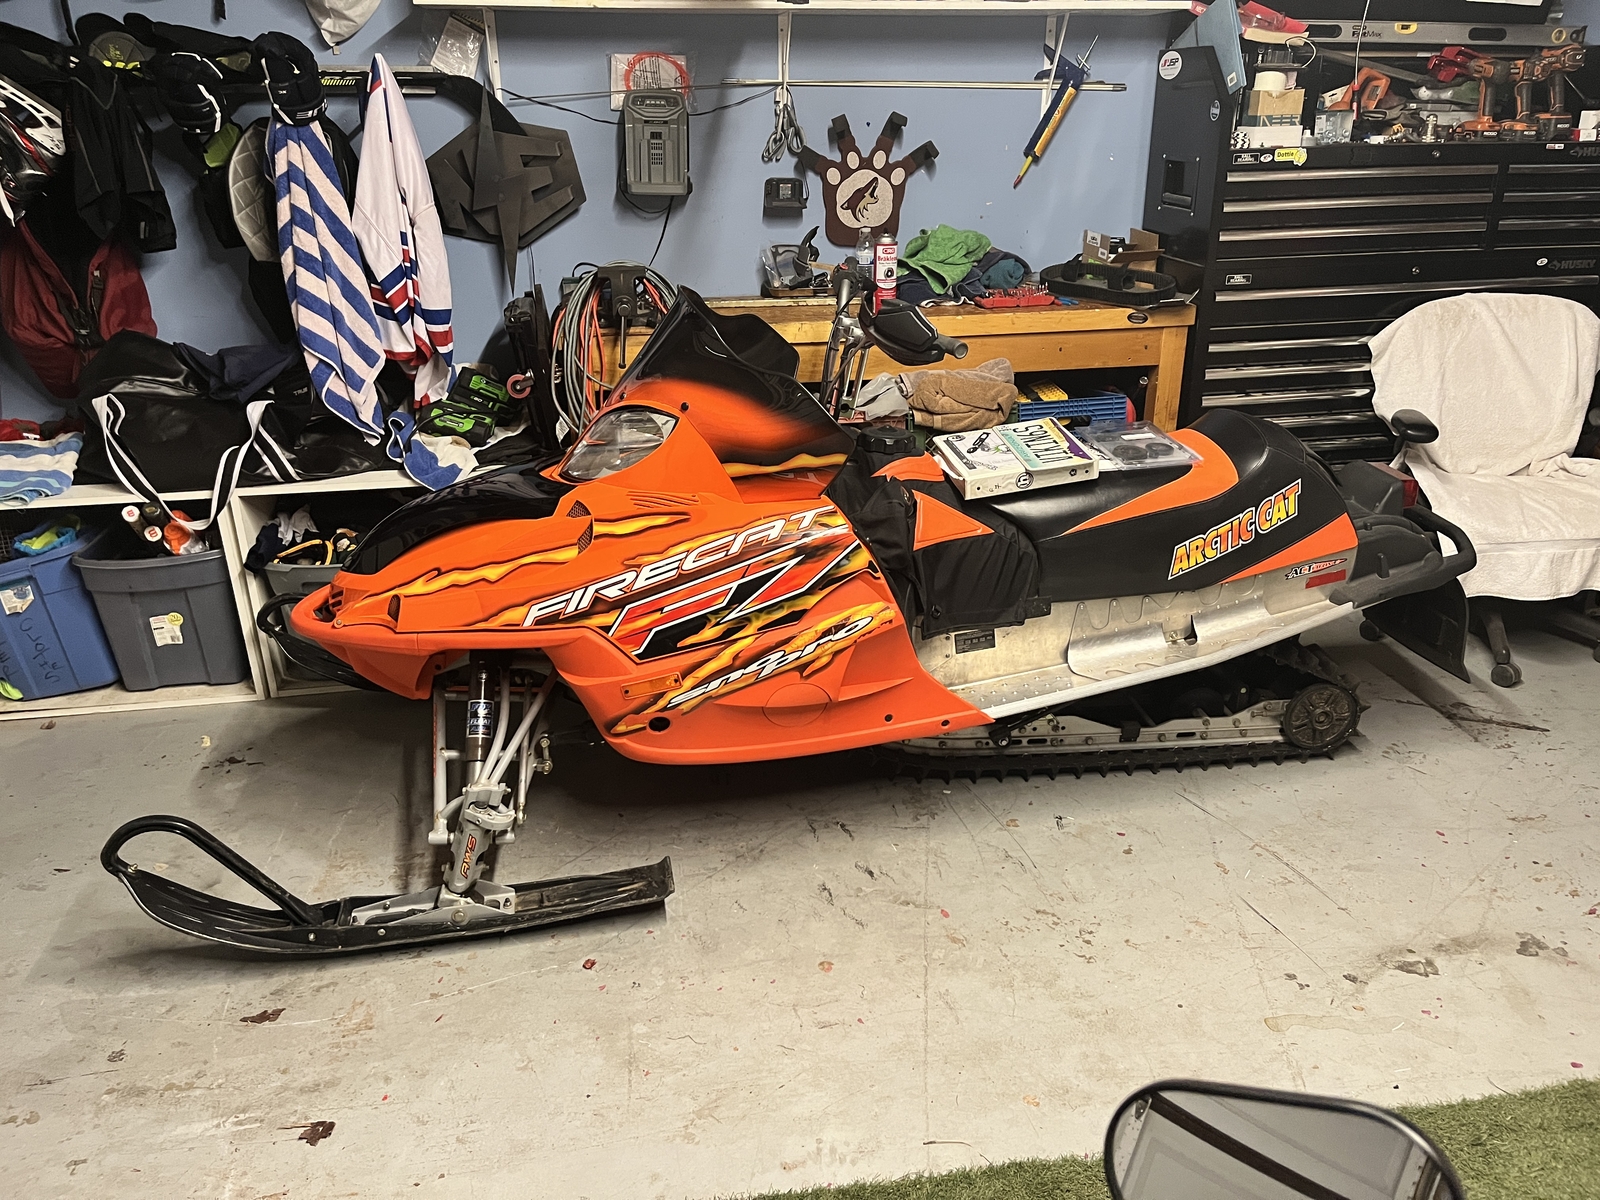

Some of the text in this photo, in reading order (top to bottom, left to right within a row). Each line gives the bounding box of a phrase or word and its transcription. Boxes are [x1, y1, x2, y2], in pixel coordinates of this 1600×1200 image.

[1560, 259, 1596, 270] HUSKY
[522, 505, 836, 627] FIRECAT
[1168, 478, 1301, 580] ARCTIC CAT
[460, 833, 477, 880] AWS
